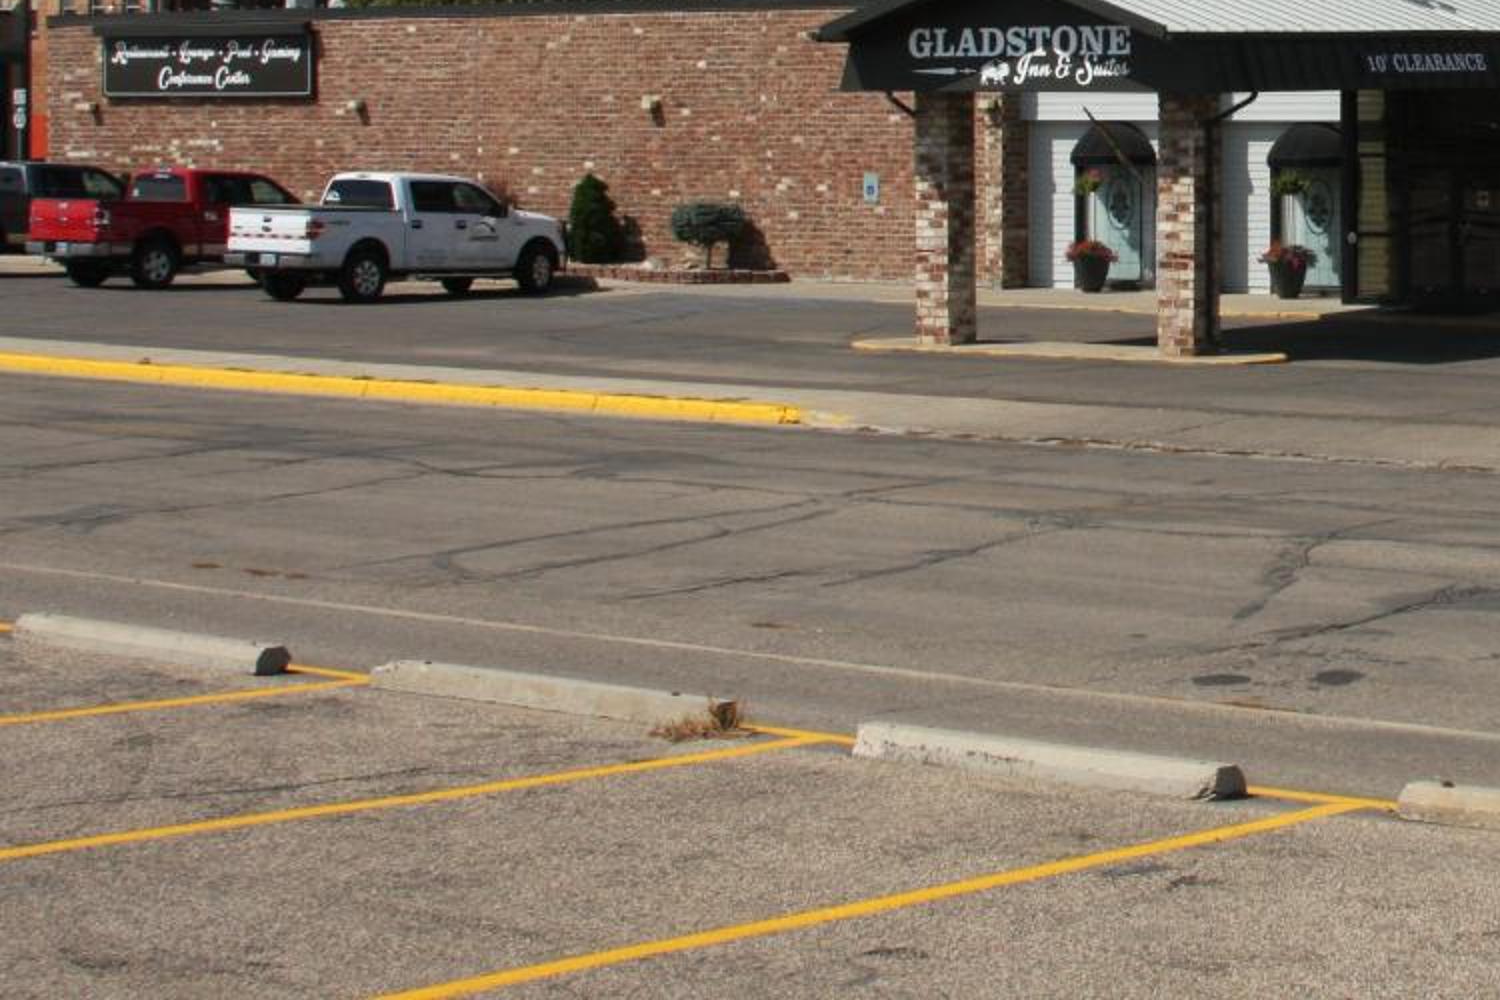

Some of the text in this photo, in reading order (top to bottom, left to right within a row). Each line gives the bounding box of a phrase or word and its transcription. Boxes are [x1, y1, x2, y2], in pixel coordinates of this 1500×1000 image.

[260, 38, 301, 63] Gaming
[907, 25, 1132, 59] GLADSTONE
[1013, 52, 1130, 85] Inn & Suites
[1392, 53, 1487, 73] CLEARANCE
[158, 65, 251, 90] Conference Center
